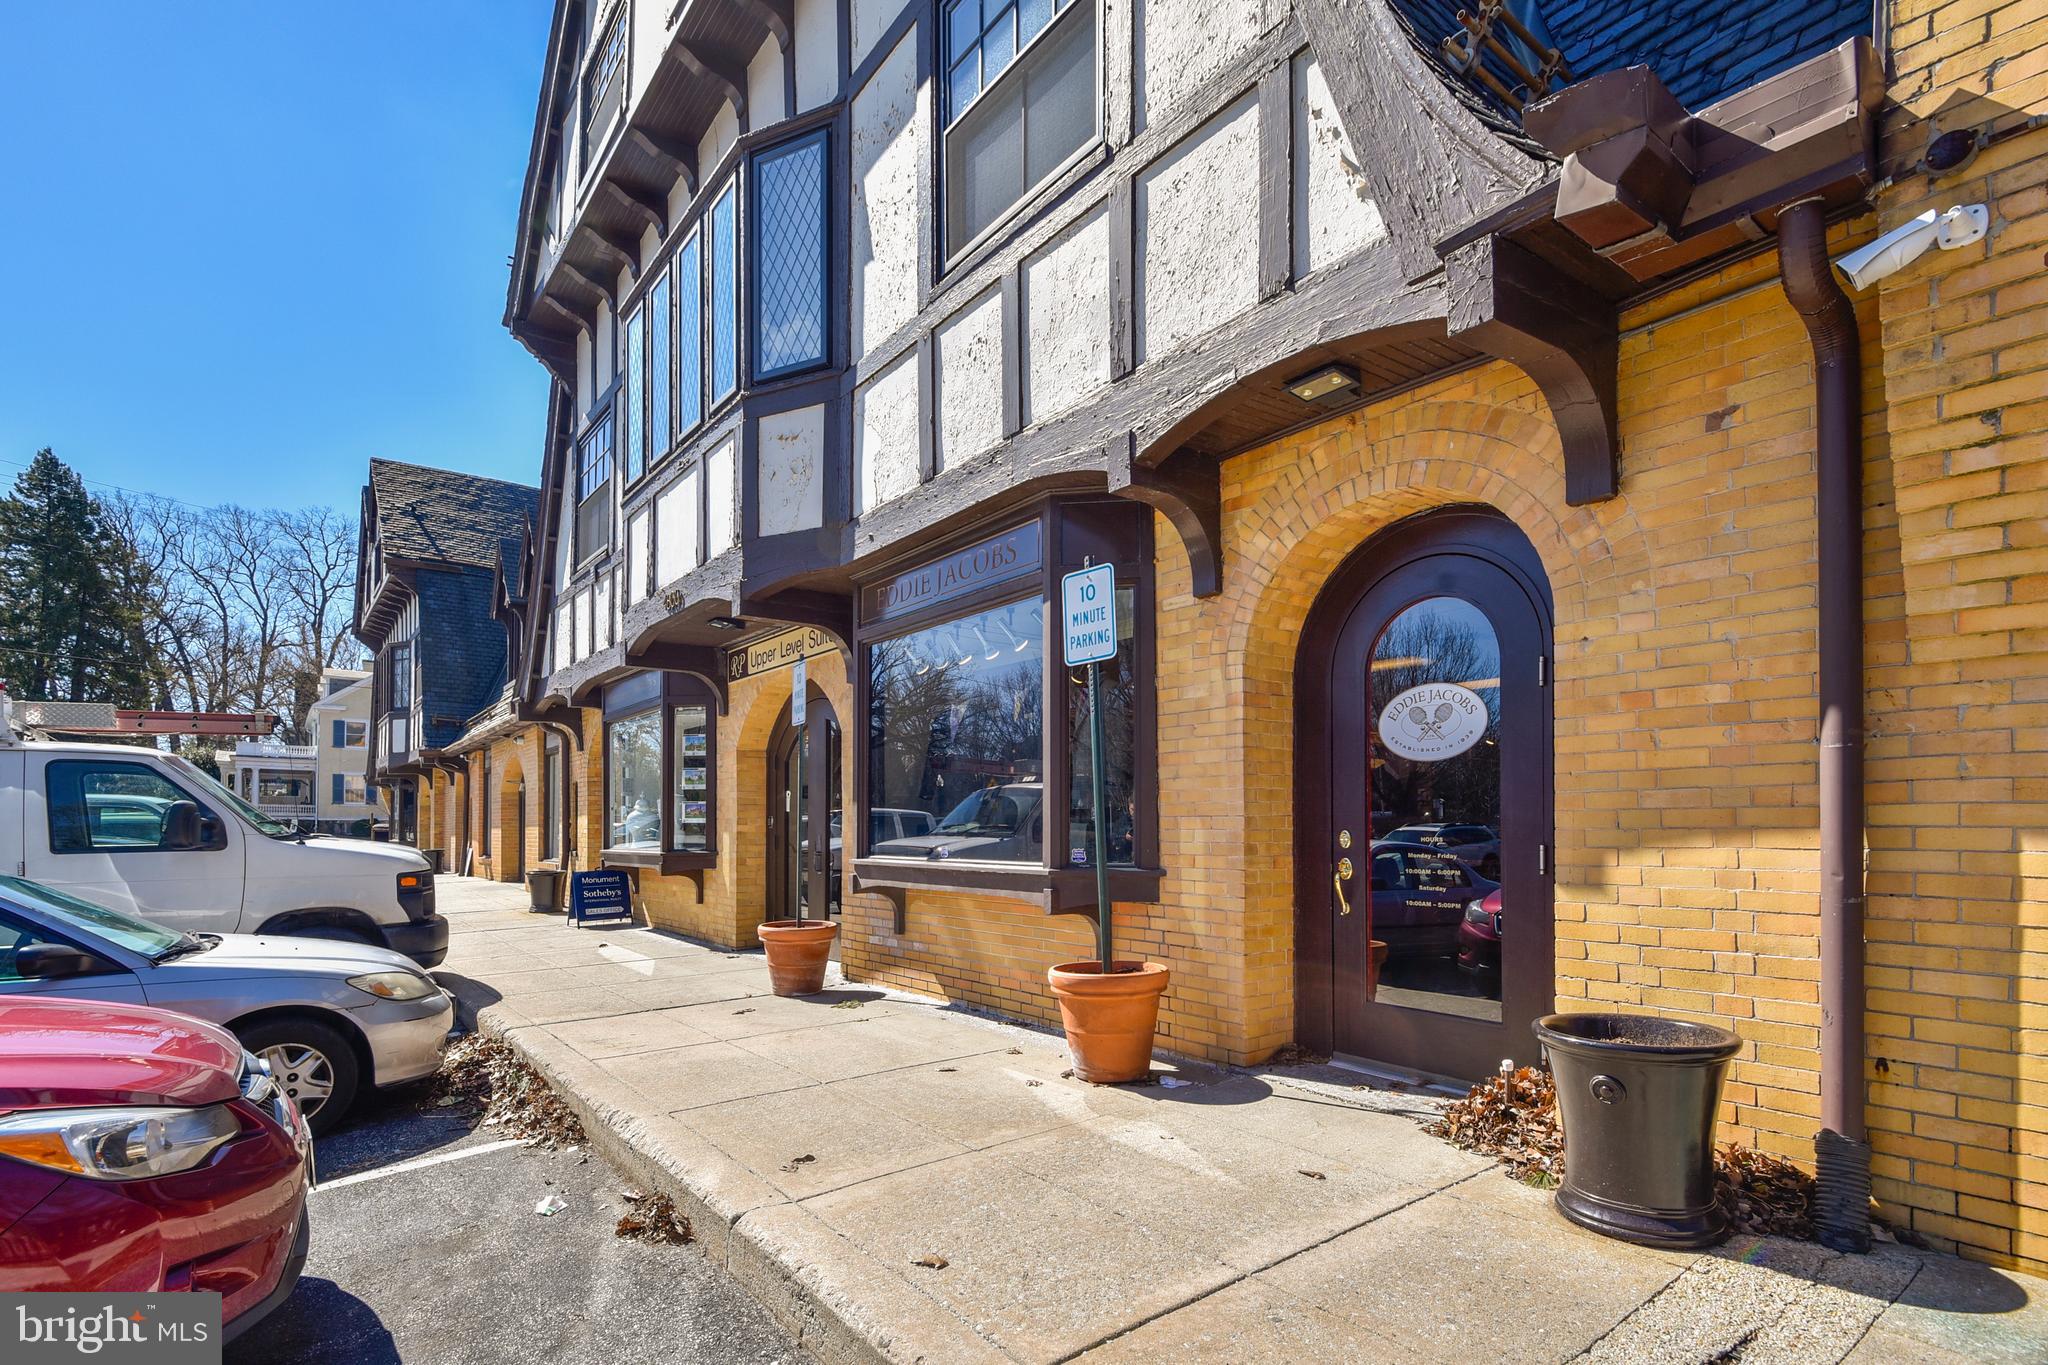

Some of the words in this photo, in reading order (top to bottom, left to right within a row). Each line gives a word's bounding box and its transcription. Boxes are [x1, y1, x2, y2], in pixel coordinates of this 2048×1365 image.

[877, 577, 931, 610] EDDIE
[935, 537, 1017, 594] JACOBS
[1080, 584, 1096, 602] 10
[1072, 606, 1106, 627] MINUTE
[1070, 628, 1110, 650] PARKING
[750, 647, 776, 670] Upper
[780, 634, 805, 658] Level
[1388, 691, 1426, 722] EDDIE
[1428, 689, 1478, 715] JACOBS
[1390, 736, 1441, 753] ESTABLISHED
[581, 875, 620, 884] Monument
[1418, 884, 1447, 893] Saturday
[583, 888, 622, 898] Sotheby's
